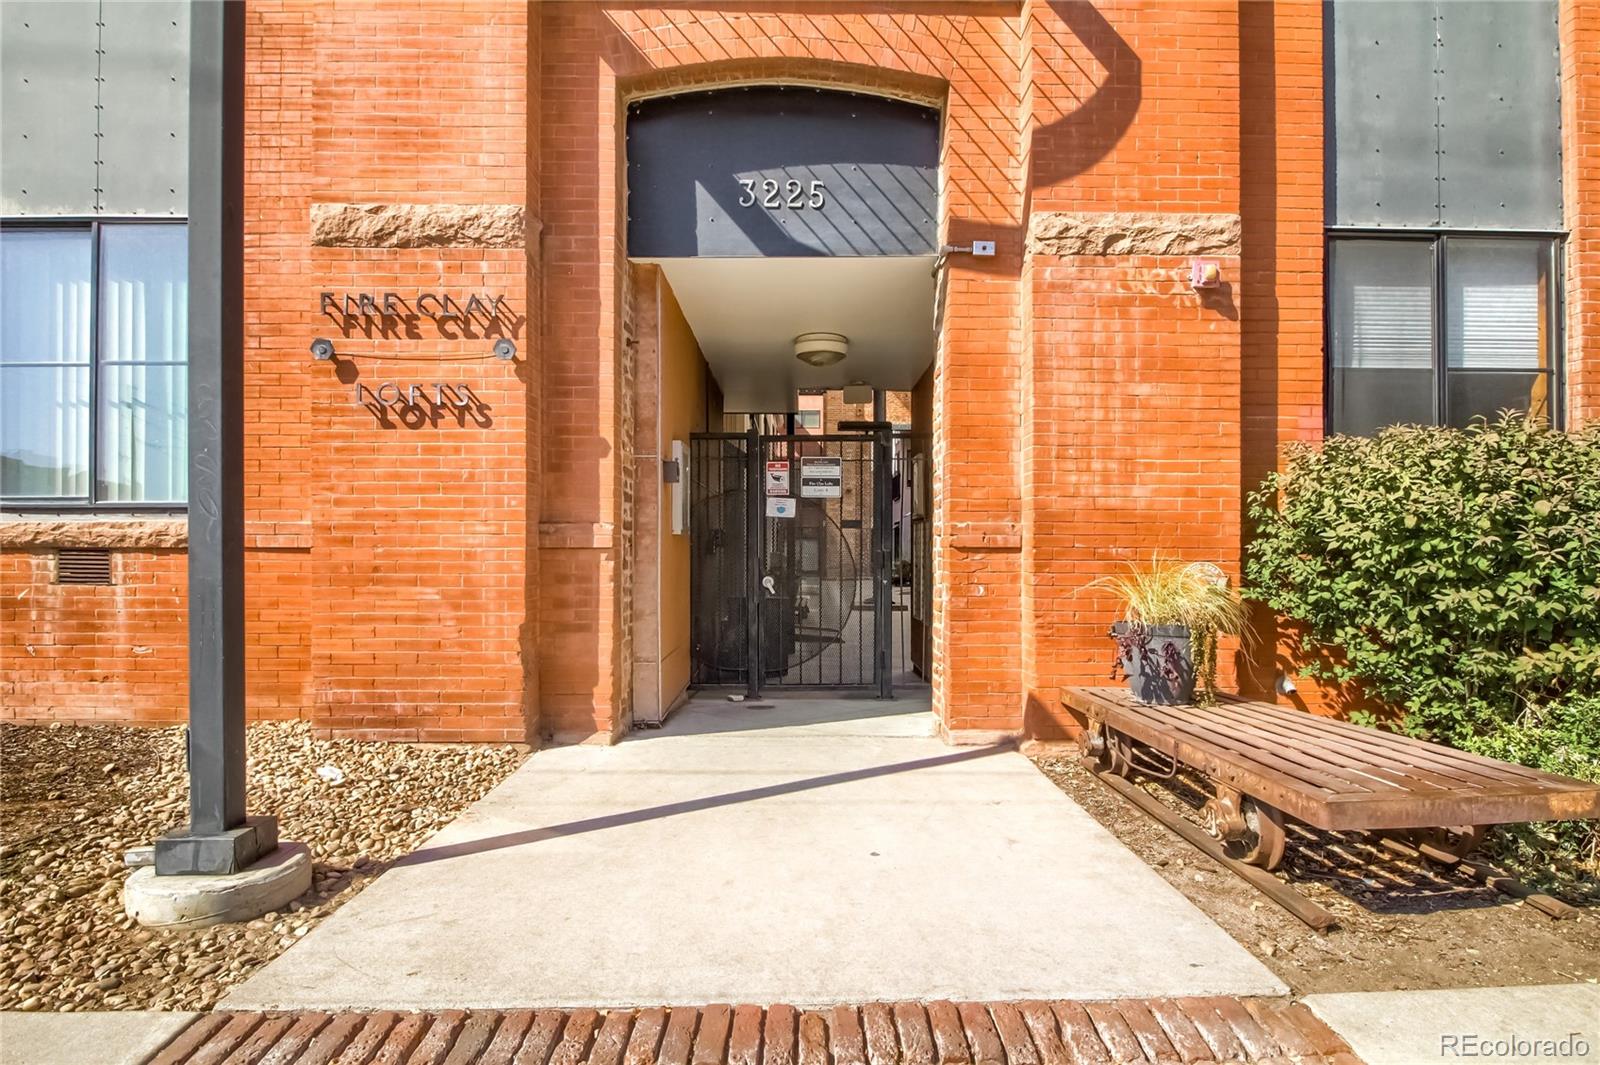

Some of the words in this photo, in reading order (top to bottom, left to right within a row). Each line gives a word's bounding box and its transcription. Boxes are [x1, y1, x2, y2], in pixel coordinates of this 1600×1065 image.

[738, 178, 825, 208] 3225
[320, 292, 398, 316] FIRE
[416, 293, 505, 317] CLAY
[355, 382, 470, 406] LOFTS
